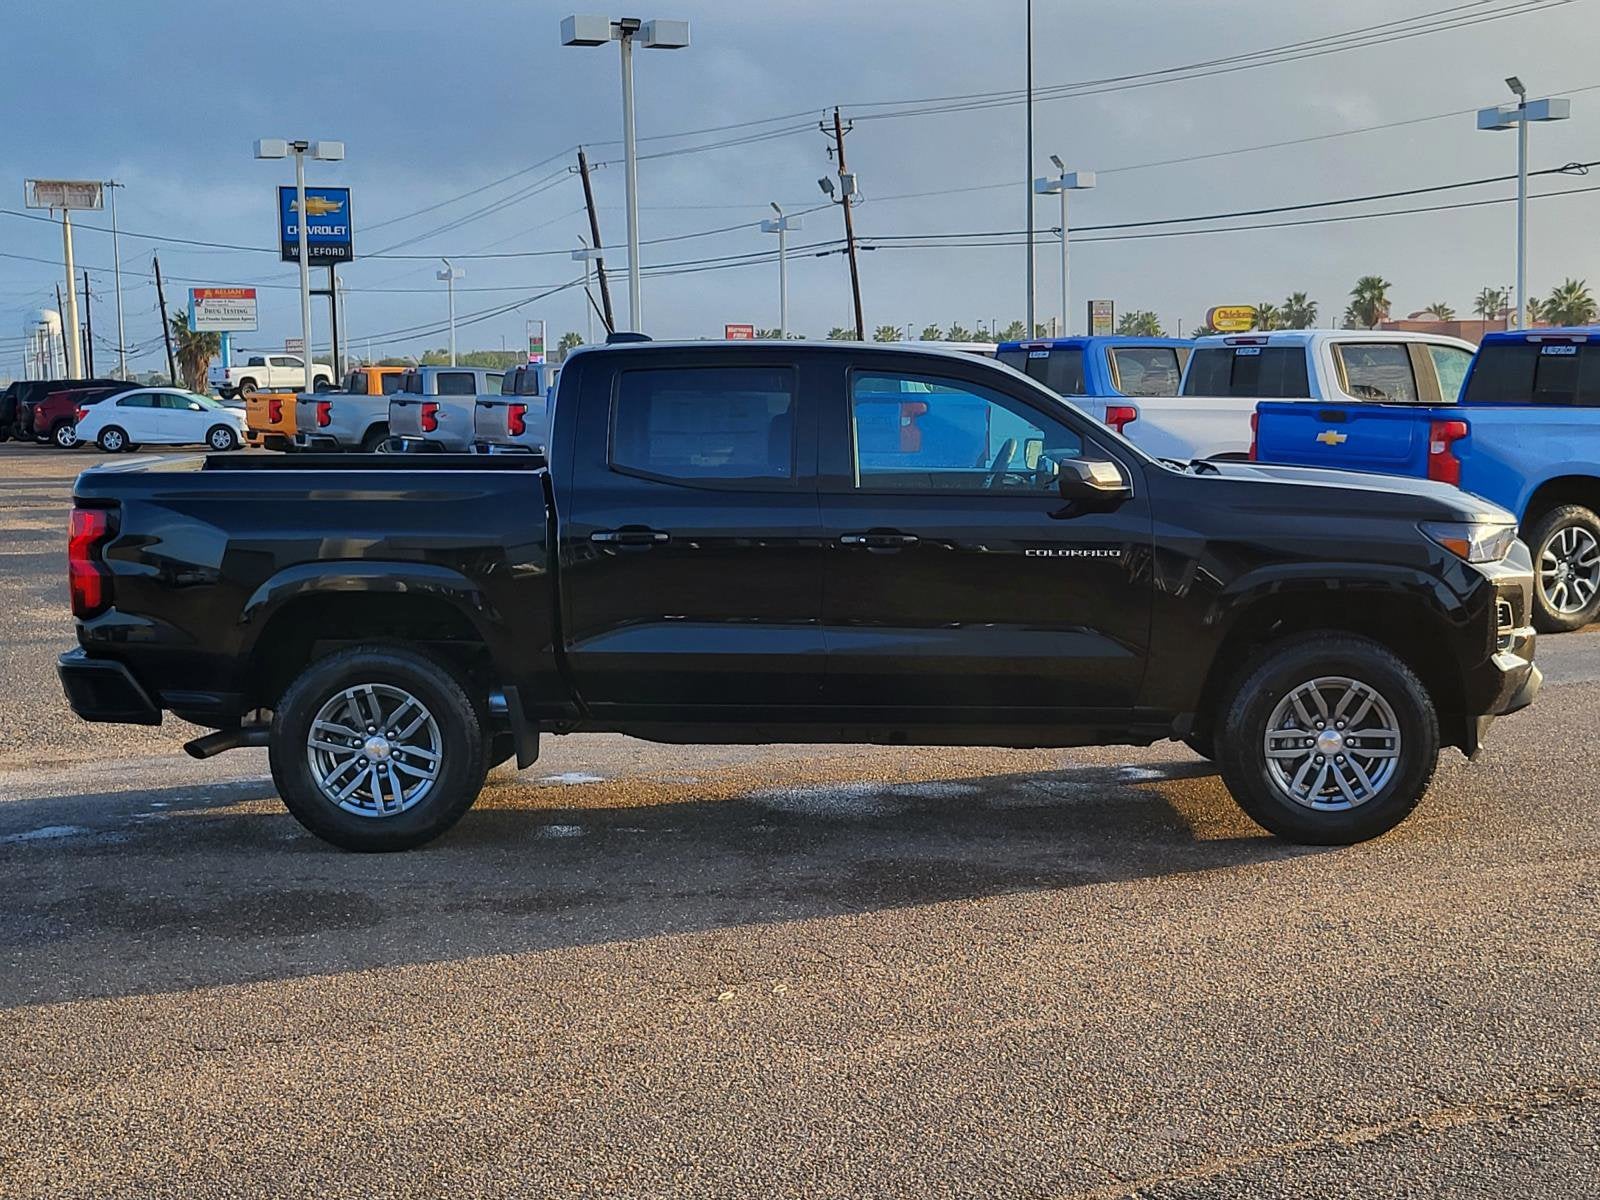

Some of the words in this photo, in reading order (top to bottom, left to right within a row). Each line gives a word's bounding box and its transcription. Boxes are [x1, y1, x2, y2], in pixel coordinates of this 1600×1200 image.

[287, 225, 347, 235] CHVROLET
[291, 247, 345, 256] WLEFORD
[1025, 549, 1121, 557] COLORADO
